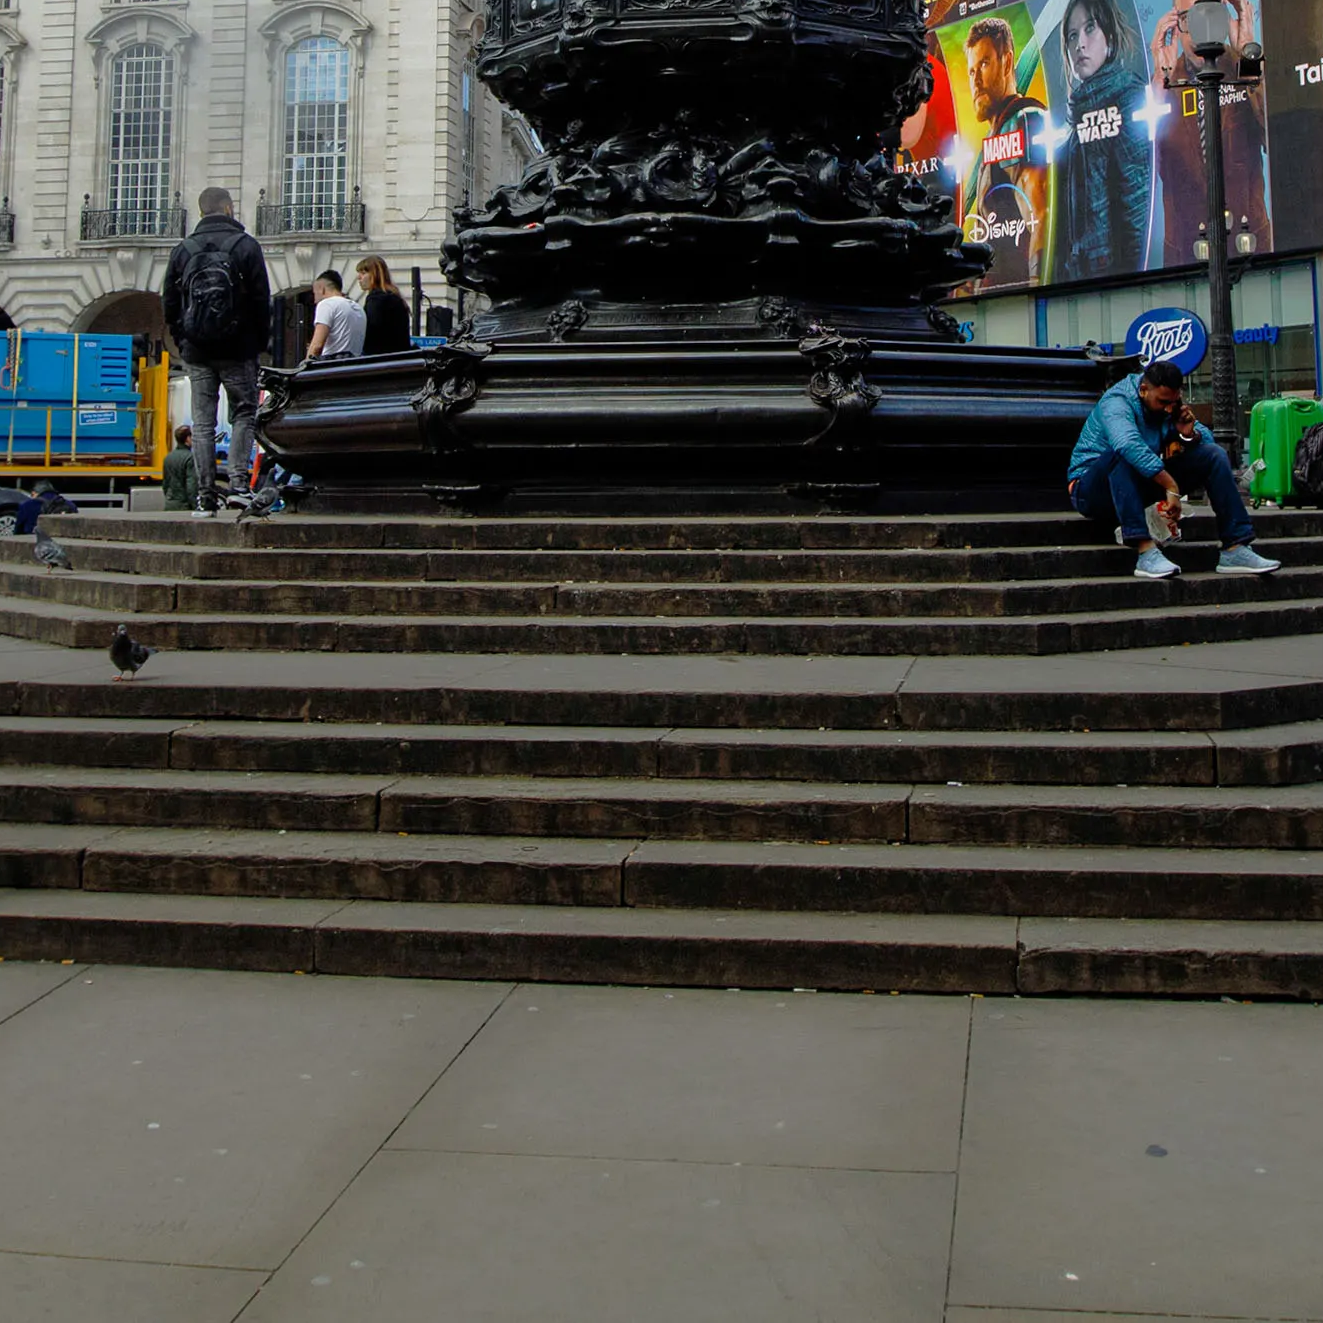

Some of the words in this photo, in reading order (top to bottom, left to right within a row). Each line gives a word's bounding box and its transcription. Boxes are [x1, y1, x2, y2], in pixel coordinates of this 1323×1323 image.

[1198, 90, 1247, 110] GRAPHIC
[1077, 105, 1122, 129] STAR
[1077, 120, 1122, 144] WARS
[983, 131, 1023, 164] MARVEL
[964, 211, 1039, 247] Disney+
[1136, 317, 1194, 367] Boots
[1233, 322, 1279, 345] eauty
